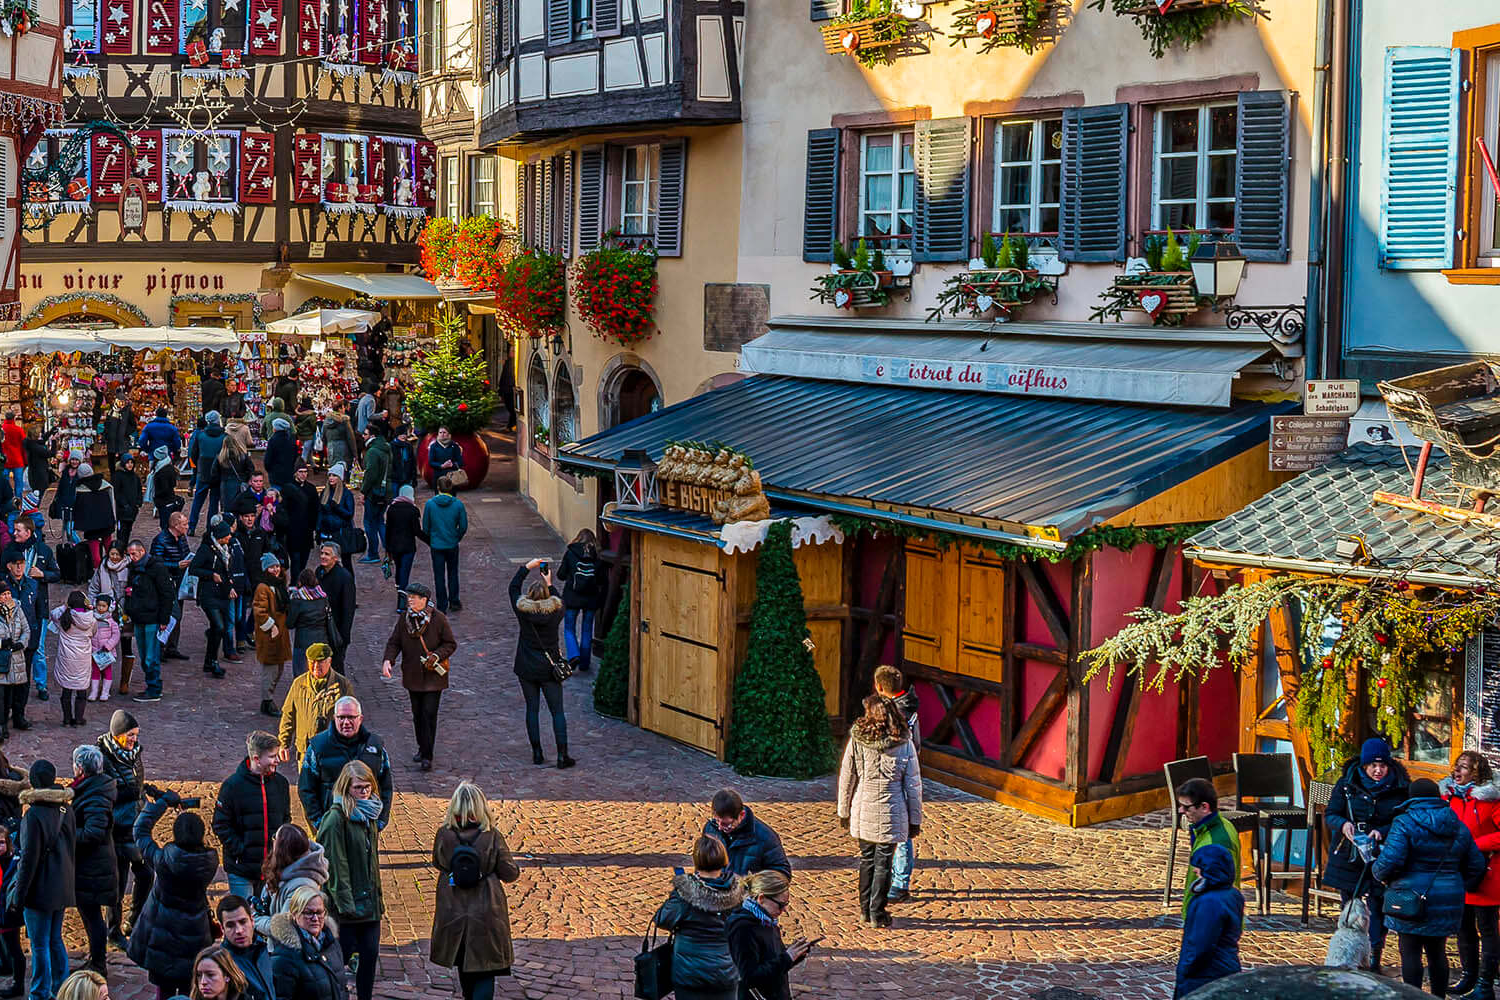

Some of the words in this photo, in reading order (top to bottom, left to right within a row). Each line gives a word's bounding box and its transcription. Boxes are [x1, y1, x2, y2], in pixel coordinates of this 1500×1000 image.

[63, 268, 123, 289] vieux
[145, 267, 225, 296] pignon
[958, 364, 984, 384] du
[660, 481, 677, 506] LE
